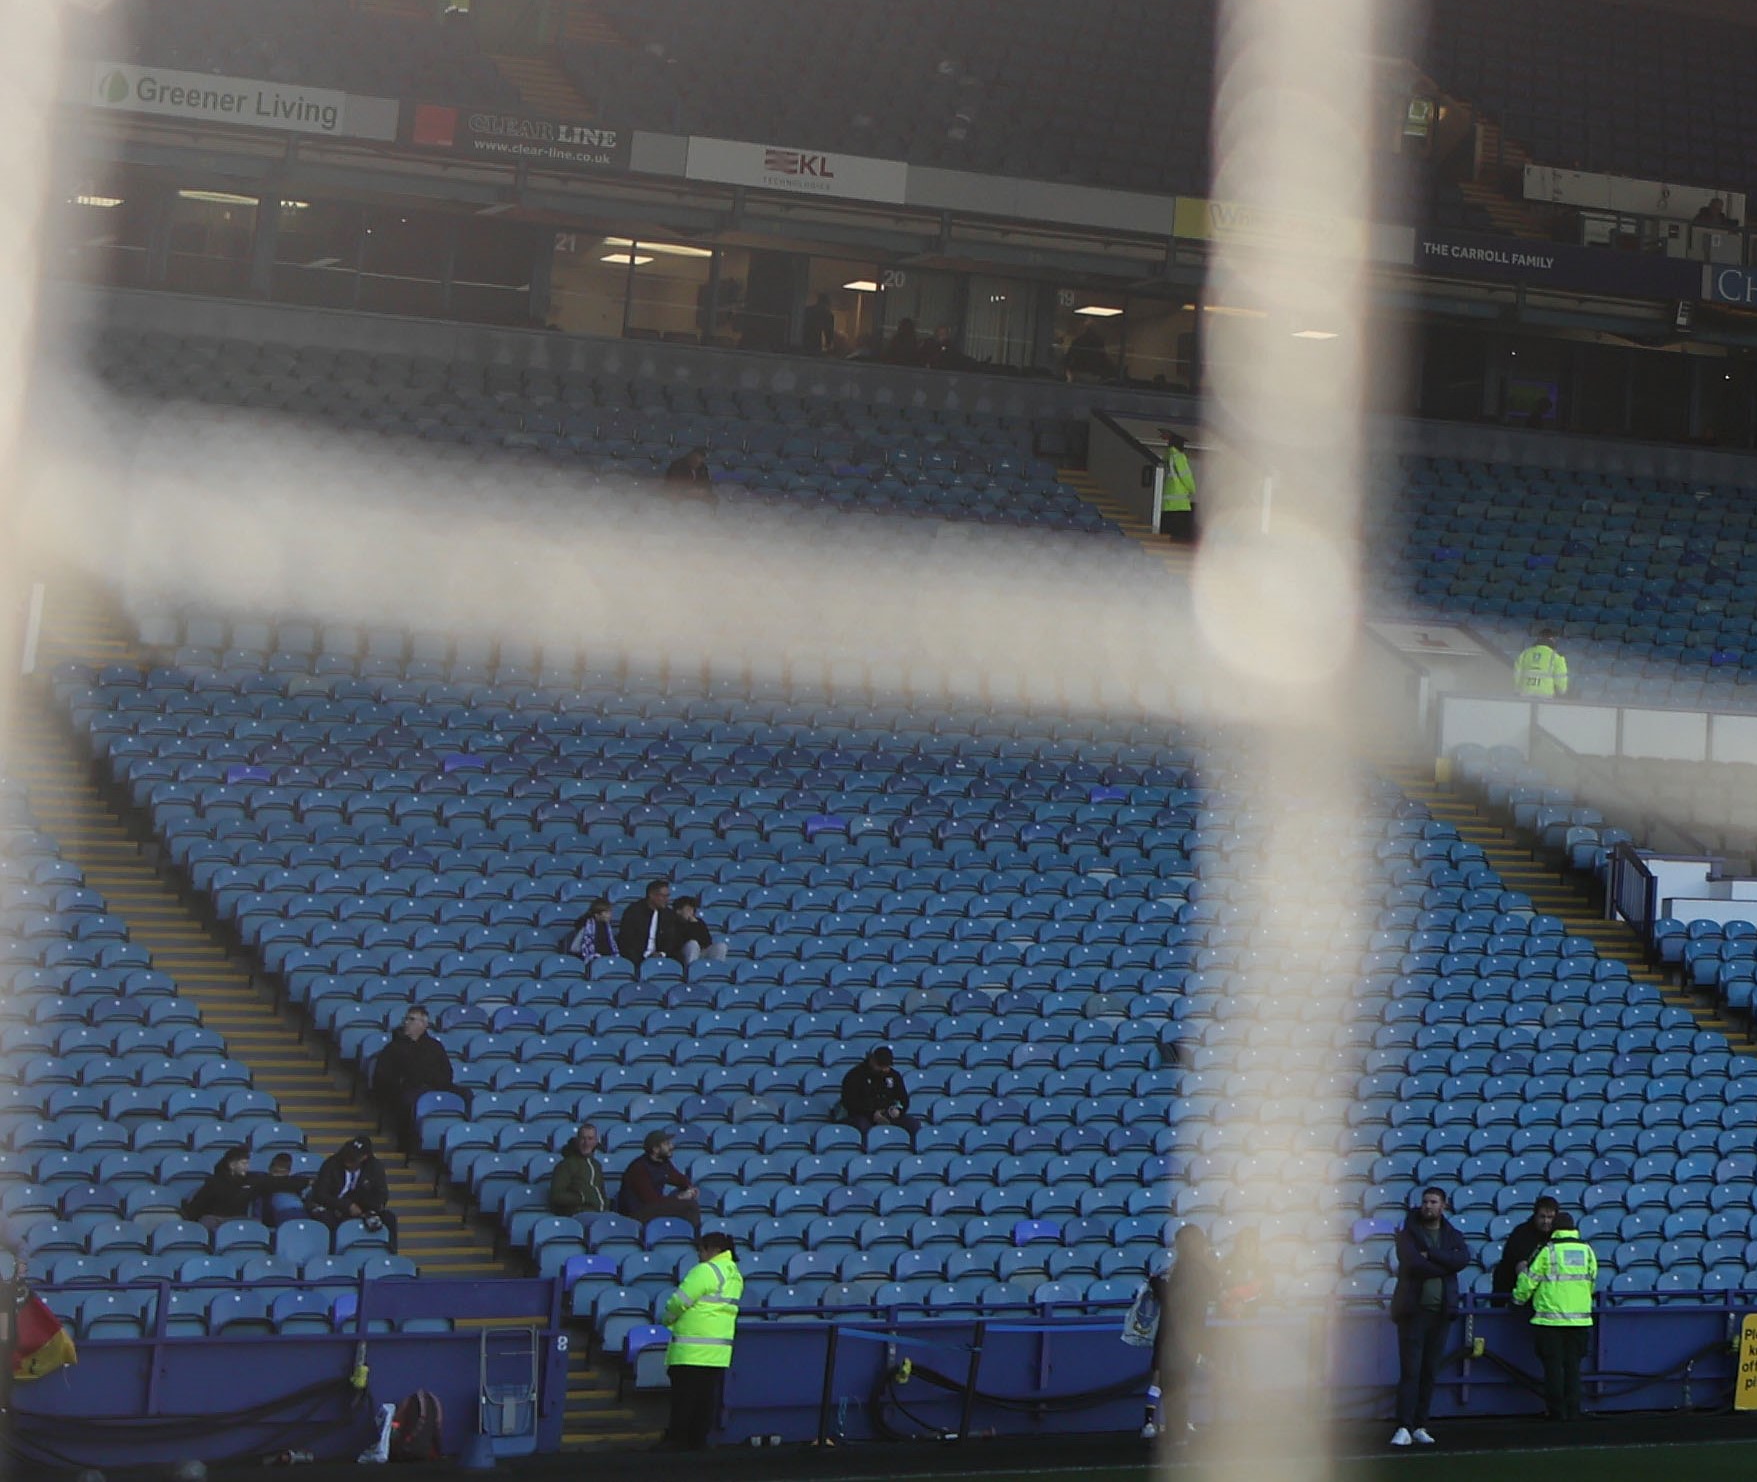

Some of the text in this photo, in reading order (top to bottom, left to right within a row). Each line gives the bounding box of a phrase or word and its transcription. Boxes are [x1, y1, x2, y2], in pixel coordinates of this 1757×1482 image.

[137, 77, 337, 130] Greener Living
[469, 112, 617, 149] CLEAR LINE
[473, 139, 611, 164] www.clear-line.co.uk
[555, 233, 577, 252] 21
[1423, 242, 1554, 270] THE CARROLL FAMILY
[883, 270, 905, 288] 20
[557, 1335, 568, 1351] 8
